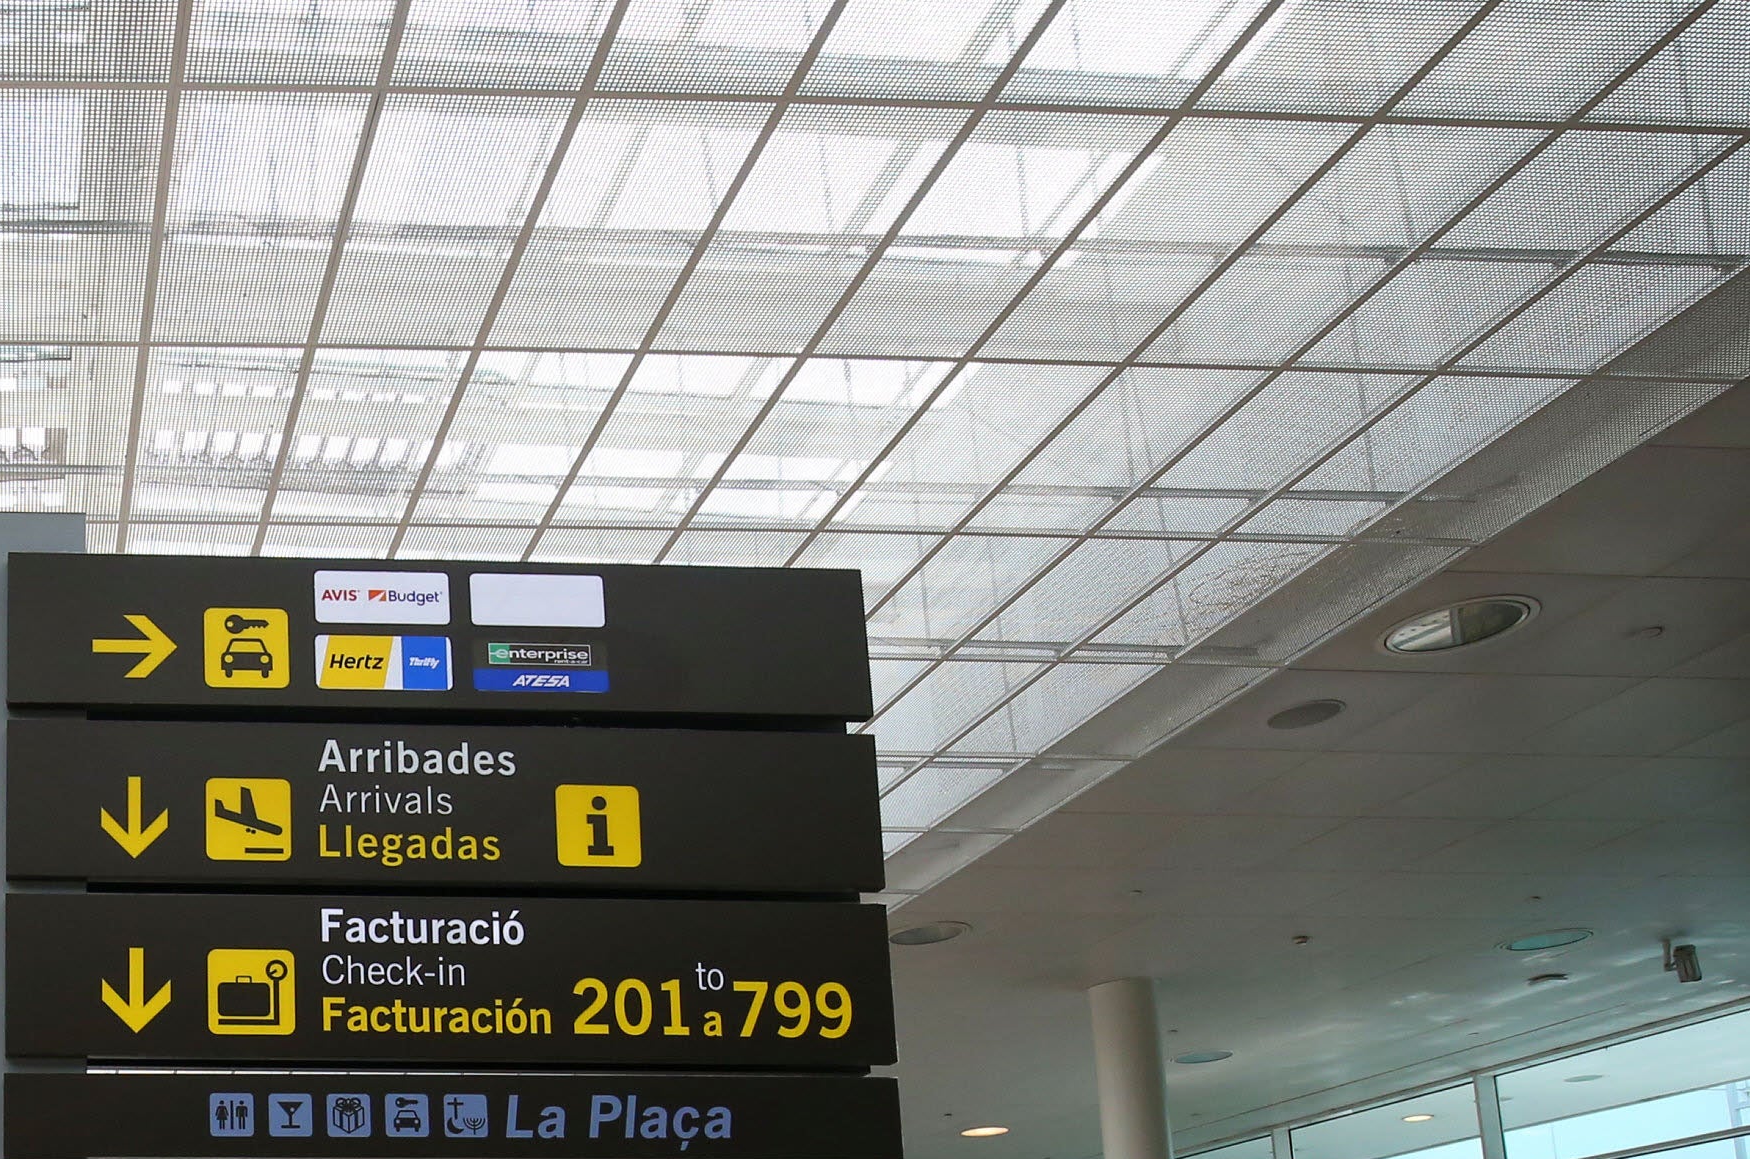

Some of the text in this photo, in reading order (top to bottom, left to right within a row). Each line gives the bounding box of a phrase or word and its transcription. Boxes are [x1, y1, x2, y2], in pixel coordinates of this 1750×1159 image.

[321, 589, 358, 601] AVIS
[388, 590, 442, 606] Budget
[329, 653, 384, 670] Hertz
[409, 656, 440, 669] Thrifty
[494, 646, 589, 663] enterprise
[512, 674, 570, 688] ATESA
[318, 739, 517, 777] Arribades
[318, 783, 453, 816] Arrivals
[319, 824, 501, 867] Llegadas
[320, 908, 525, 946] Facturació
[321, 953, 466, 987] Check-in
[695, 960, 725, 991] to
[322, 977, 852, 1039] Facturación 201 a 799
[505, 1095, 733, 1151] La Plaça
